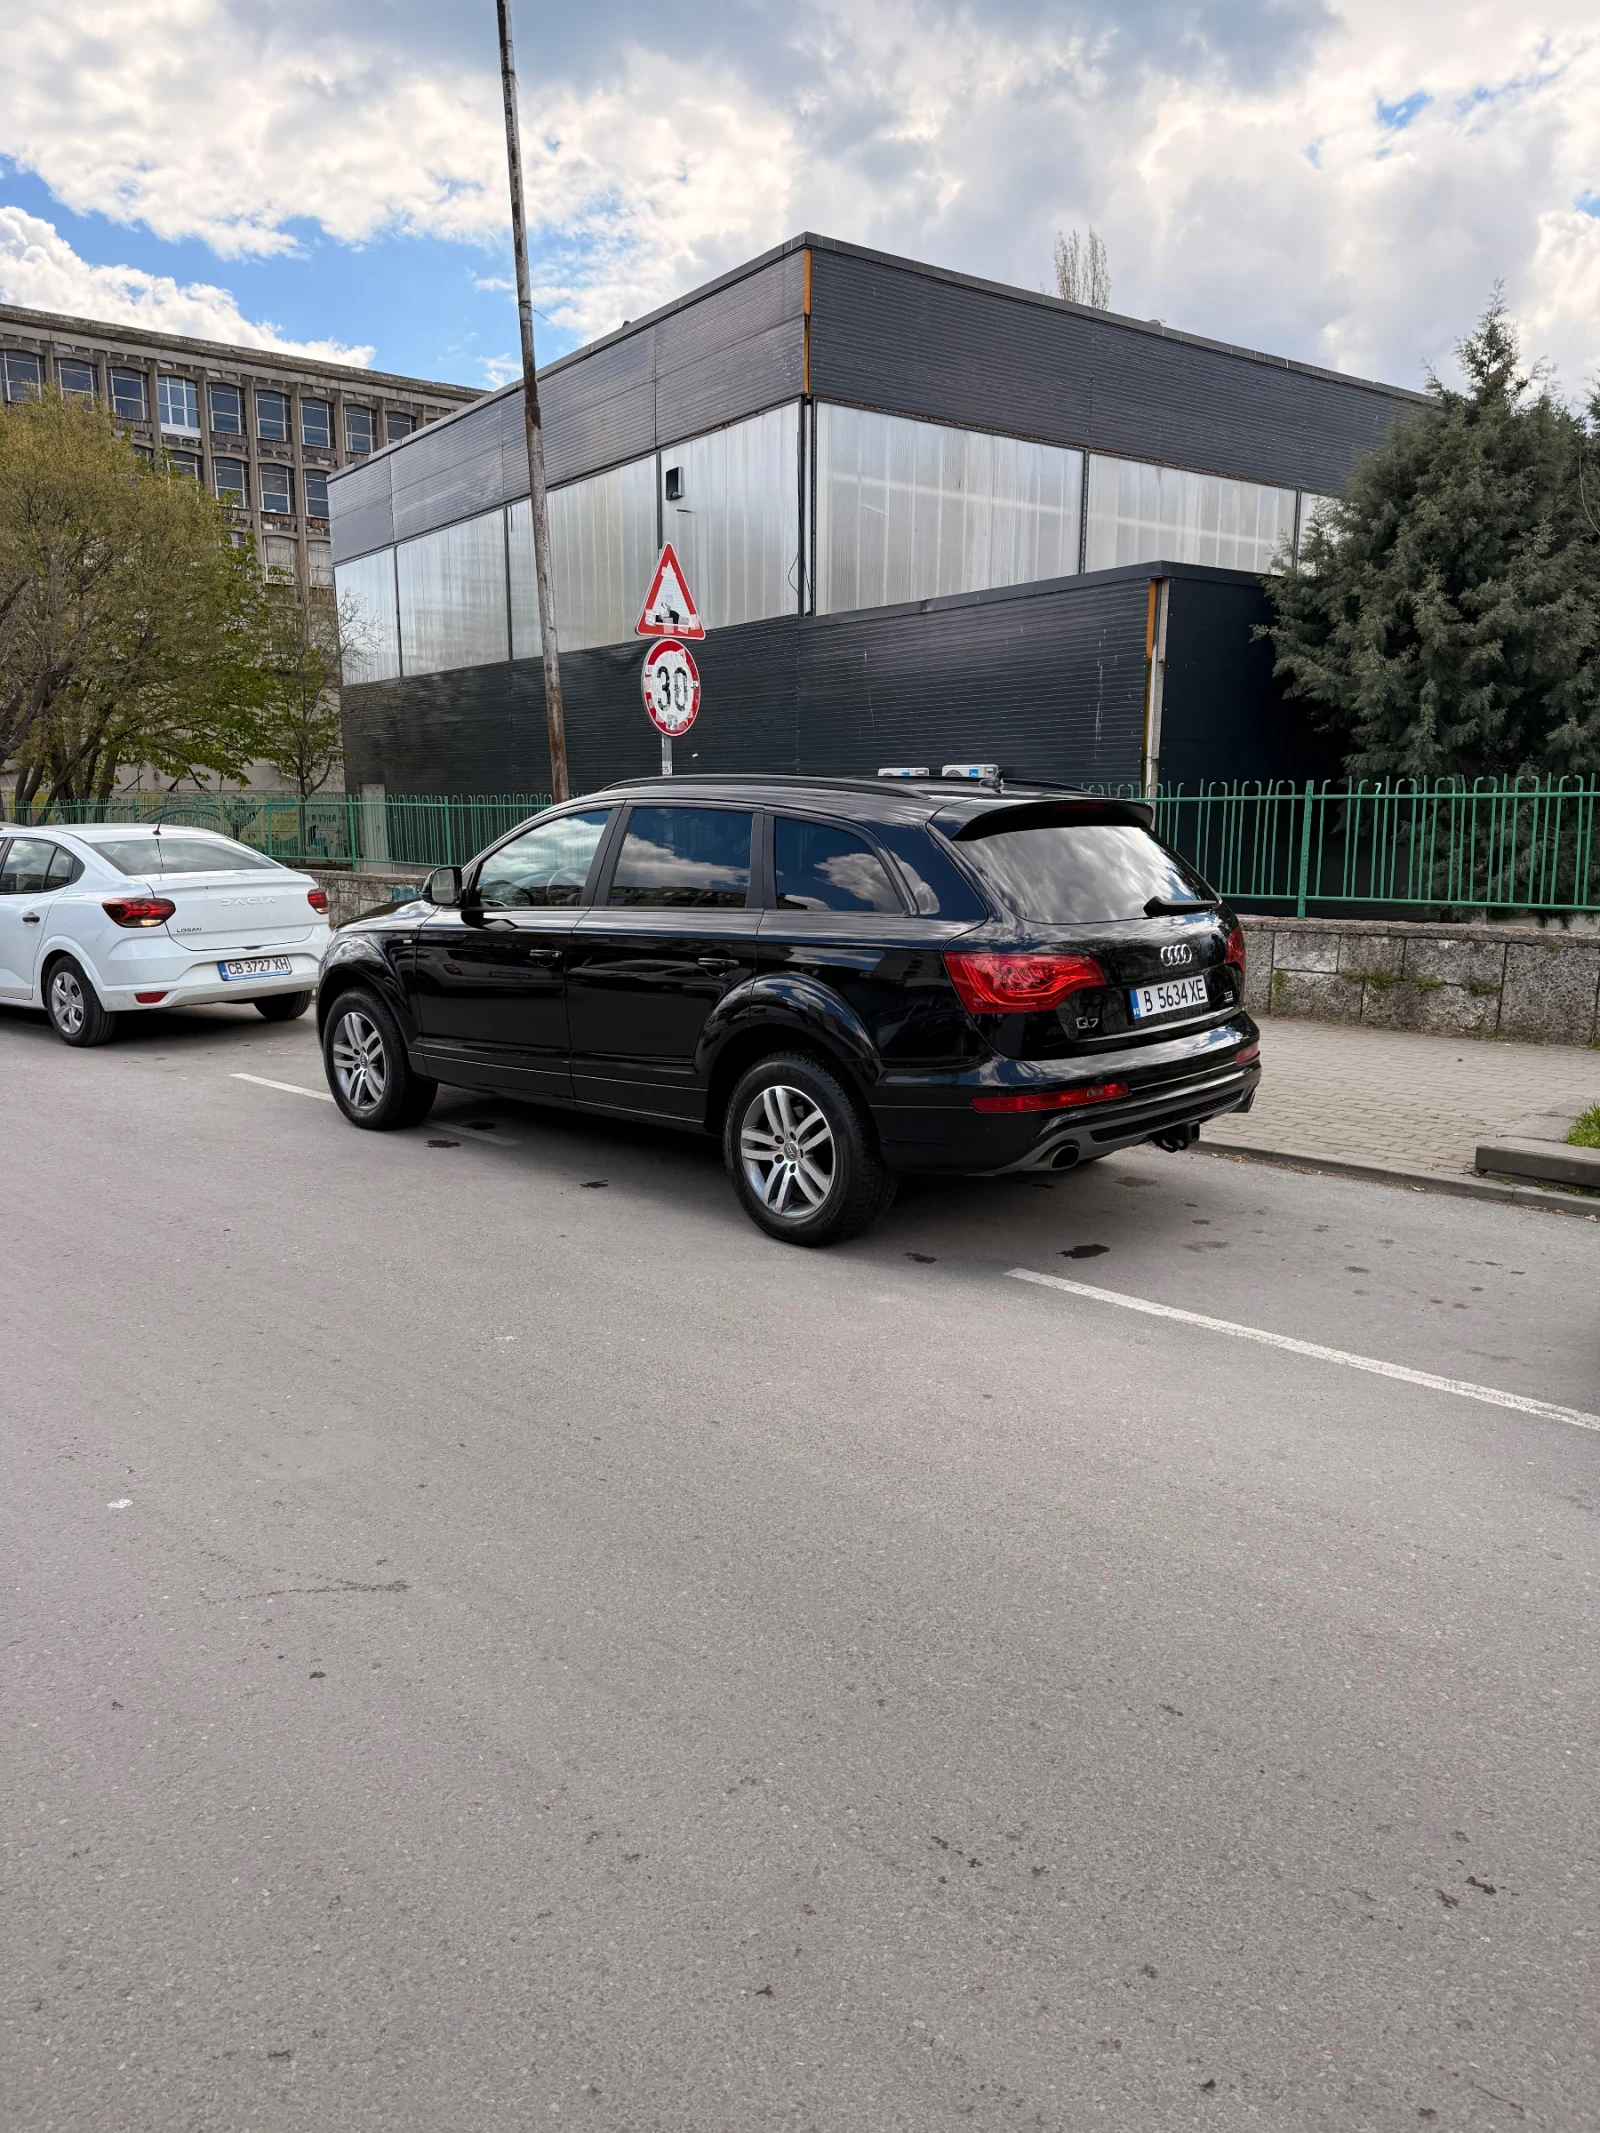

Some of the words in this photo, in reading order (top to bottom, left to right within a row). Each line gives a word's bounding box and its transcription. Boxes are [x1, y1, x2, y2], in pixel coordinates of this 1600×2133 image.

[657, 666, 688, 711] 30
[220, 897, 276, 906] DACIA
[227, 962, 244, 975] CB
[245, 960, 270, 973] 3727
[272, 958, 289, 971] XH
[1144, 990, 1153, 1012] B
[1157, 982, 1189, 1009] 5634
[1188, 978, 1206, 1002] XE
[1075, 1016, 1099, 1029] Q7
